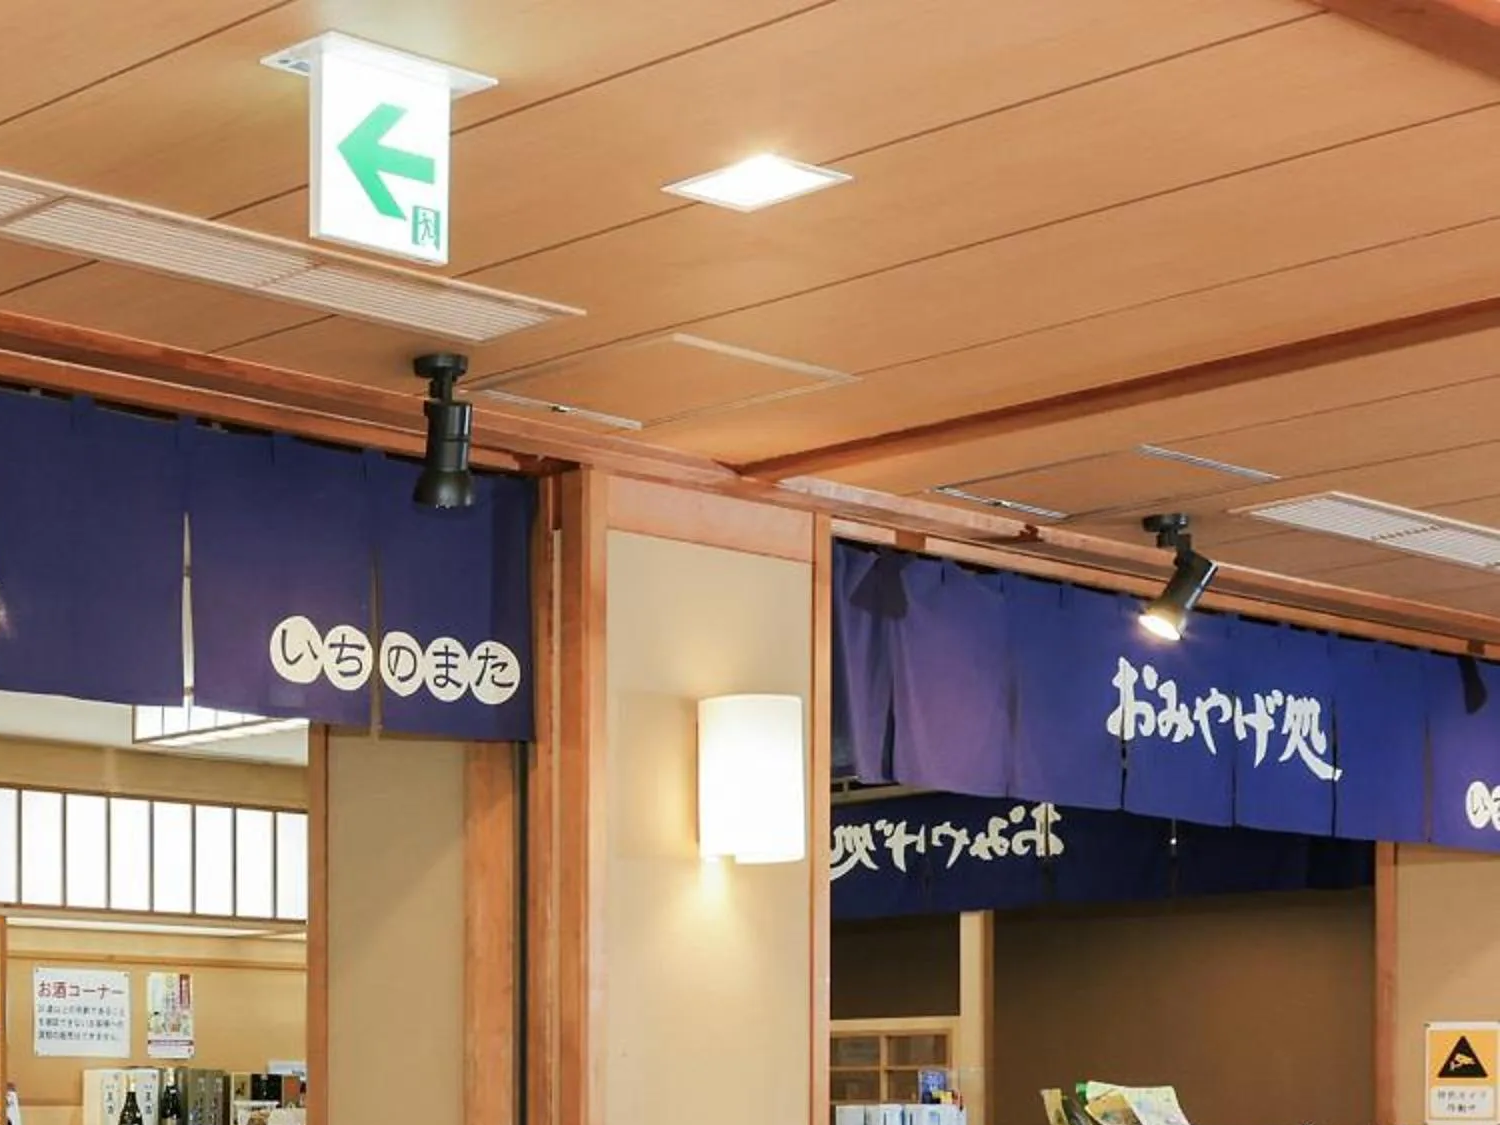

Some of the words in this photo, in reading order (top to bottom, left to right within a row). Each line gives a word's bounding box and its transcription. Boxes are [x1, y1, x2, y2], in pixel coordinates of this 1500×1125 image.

[280, 627, 516, 690] いちのまた
[1106, 657, 1342, 780] おみやげ処
[38, 980, 124, 1000] お酒コーナー
